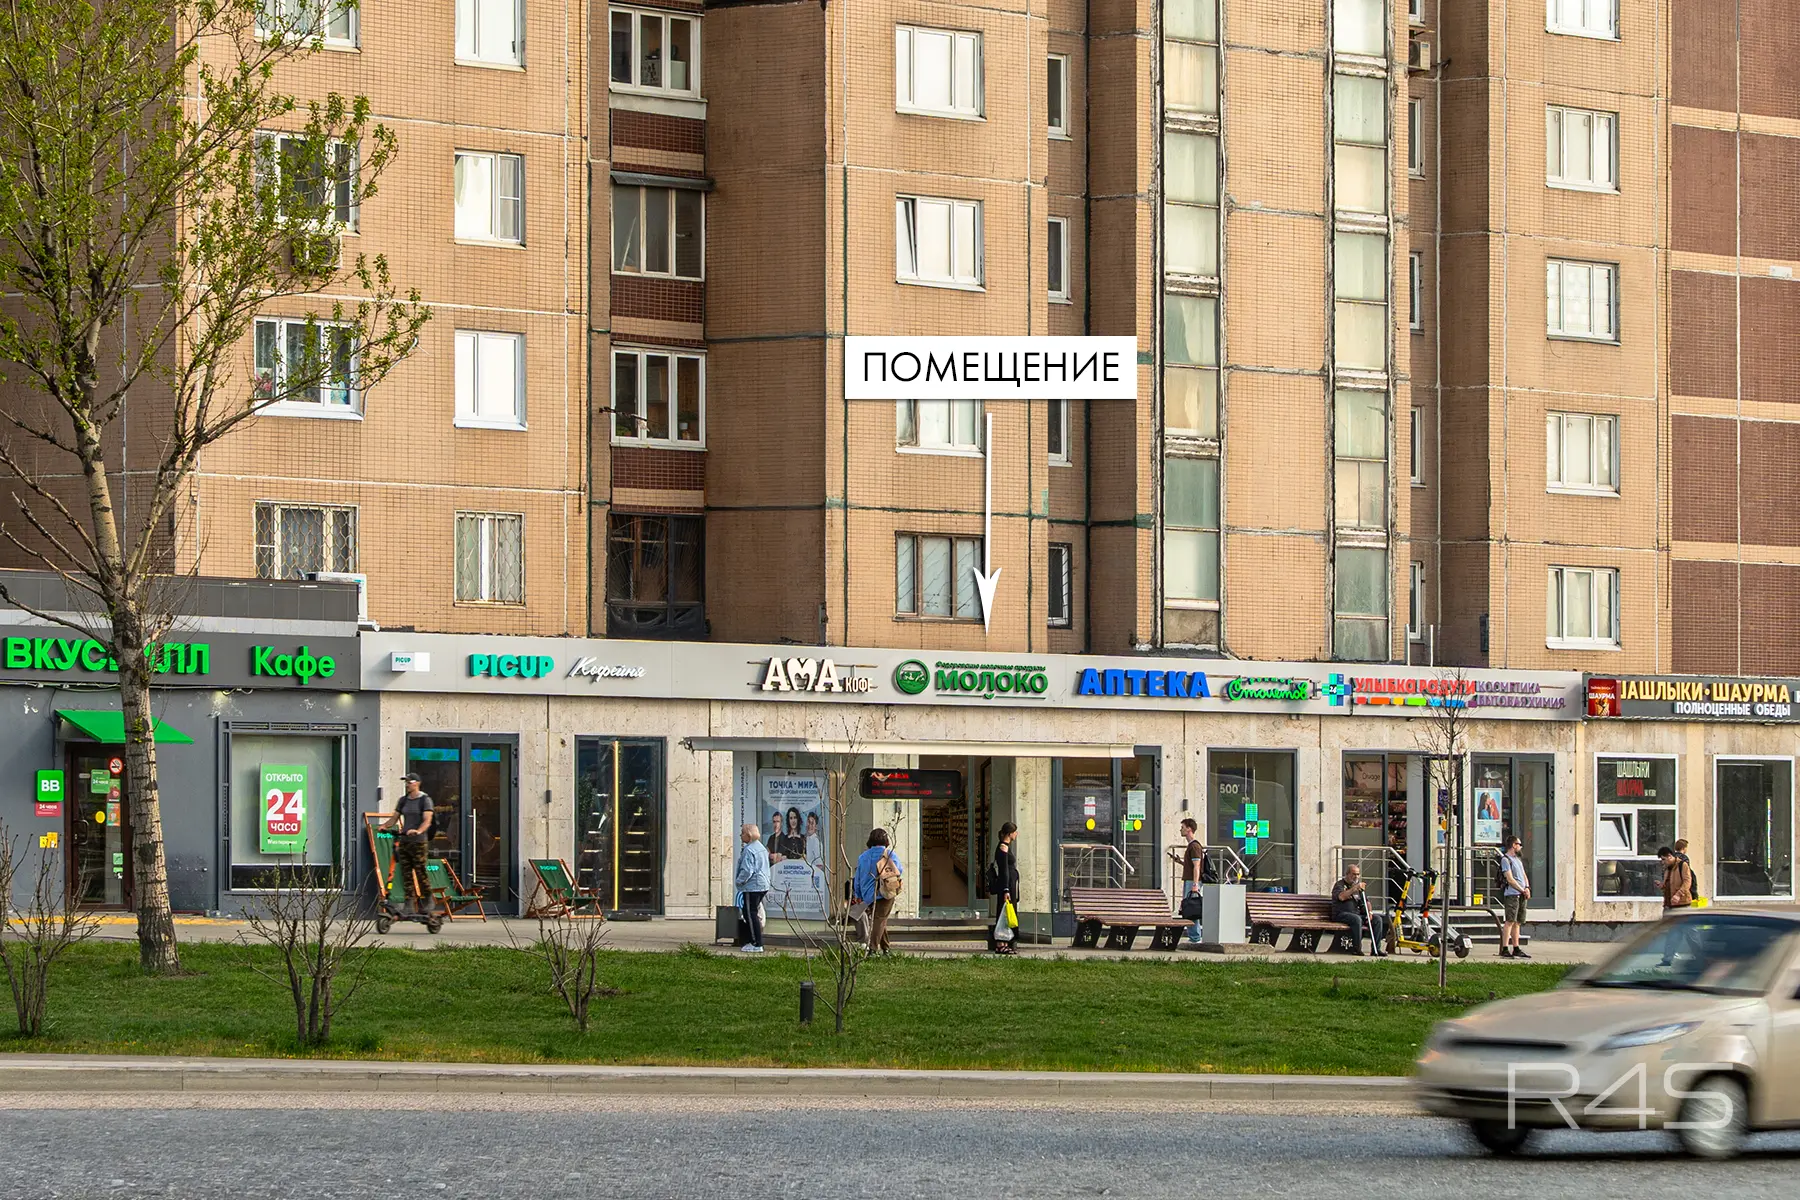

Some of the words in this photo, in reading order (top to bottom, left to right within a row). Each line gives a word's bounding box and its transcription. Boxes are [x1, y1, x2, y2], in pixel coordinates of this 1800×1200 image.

[254, 646, 336, 684] Кафе
[470, 654, 555, 677] PICUP
[571, 656, 647, 682] Кофейня
[845, 677, 873, 693] КОФЕ
[936, 669, 1048, 694] МОЛОКО
[1079, 668, 1211, 698] АПТЕКА
[1478, 681, 1541, 693] КОСМЕТИКА
[1712, 683, 1790, 703] ШАУРМА
[1477, 695, 1527, 707] БЫТОВАЯ
[1527, 696, 1566, 709] ХИМИЯ
[1675, 702, 1750, 716] ПОЛНОЦЕННЫЕ
[1755, 703, 1791, 717] ОБЕДЫ
[265, 773, 303, 782] ОТКРЫТО
[797, 781, 817, 789] МИРА
[266, 788, 306, 821] 24
[270, 823, 298, 832] часа
[1246, 823, 1258, 836] 24
